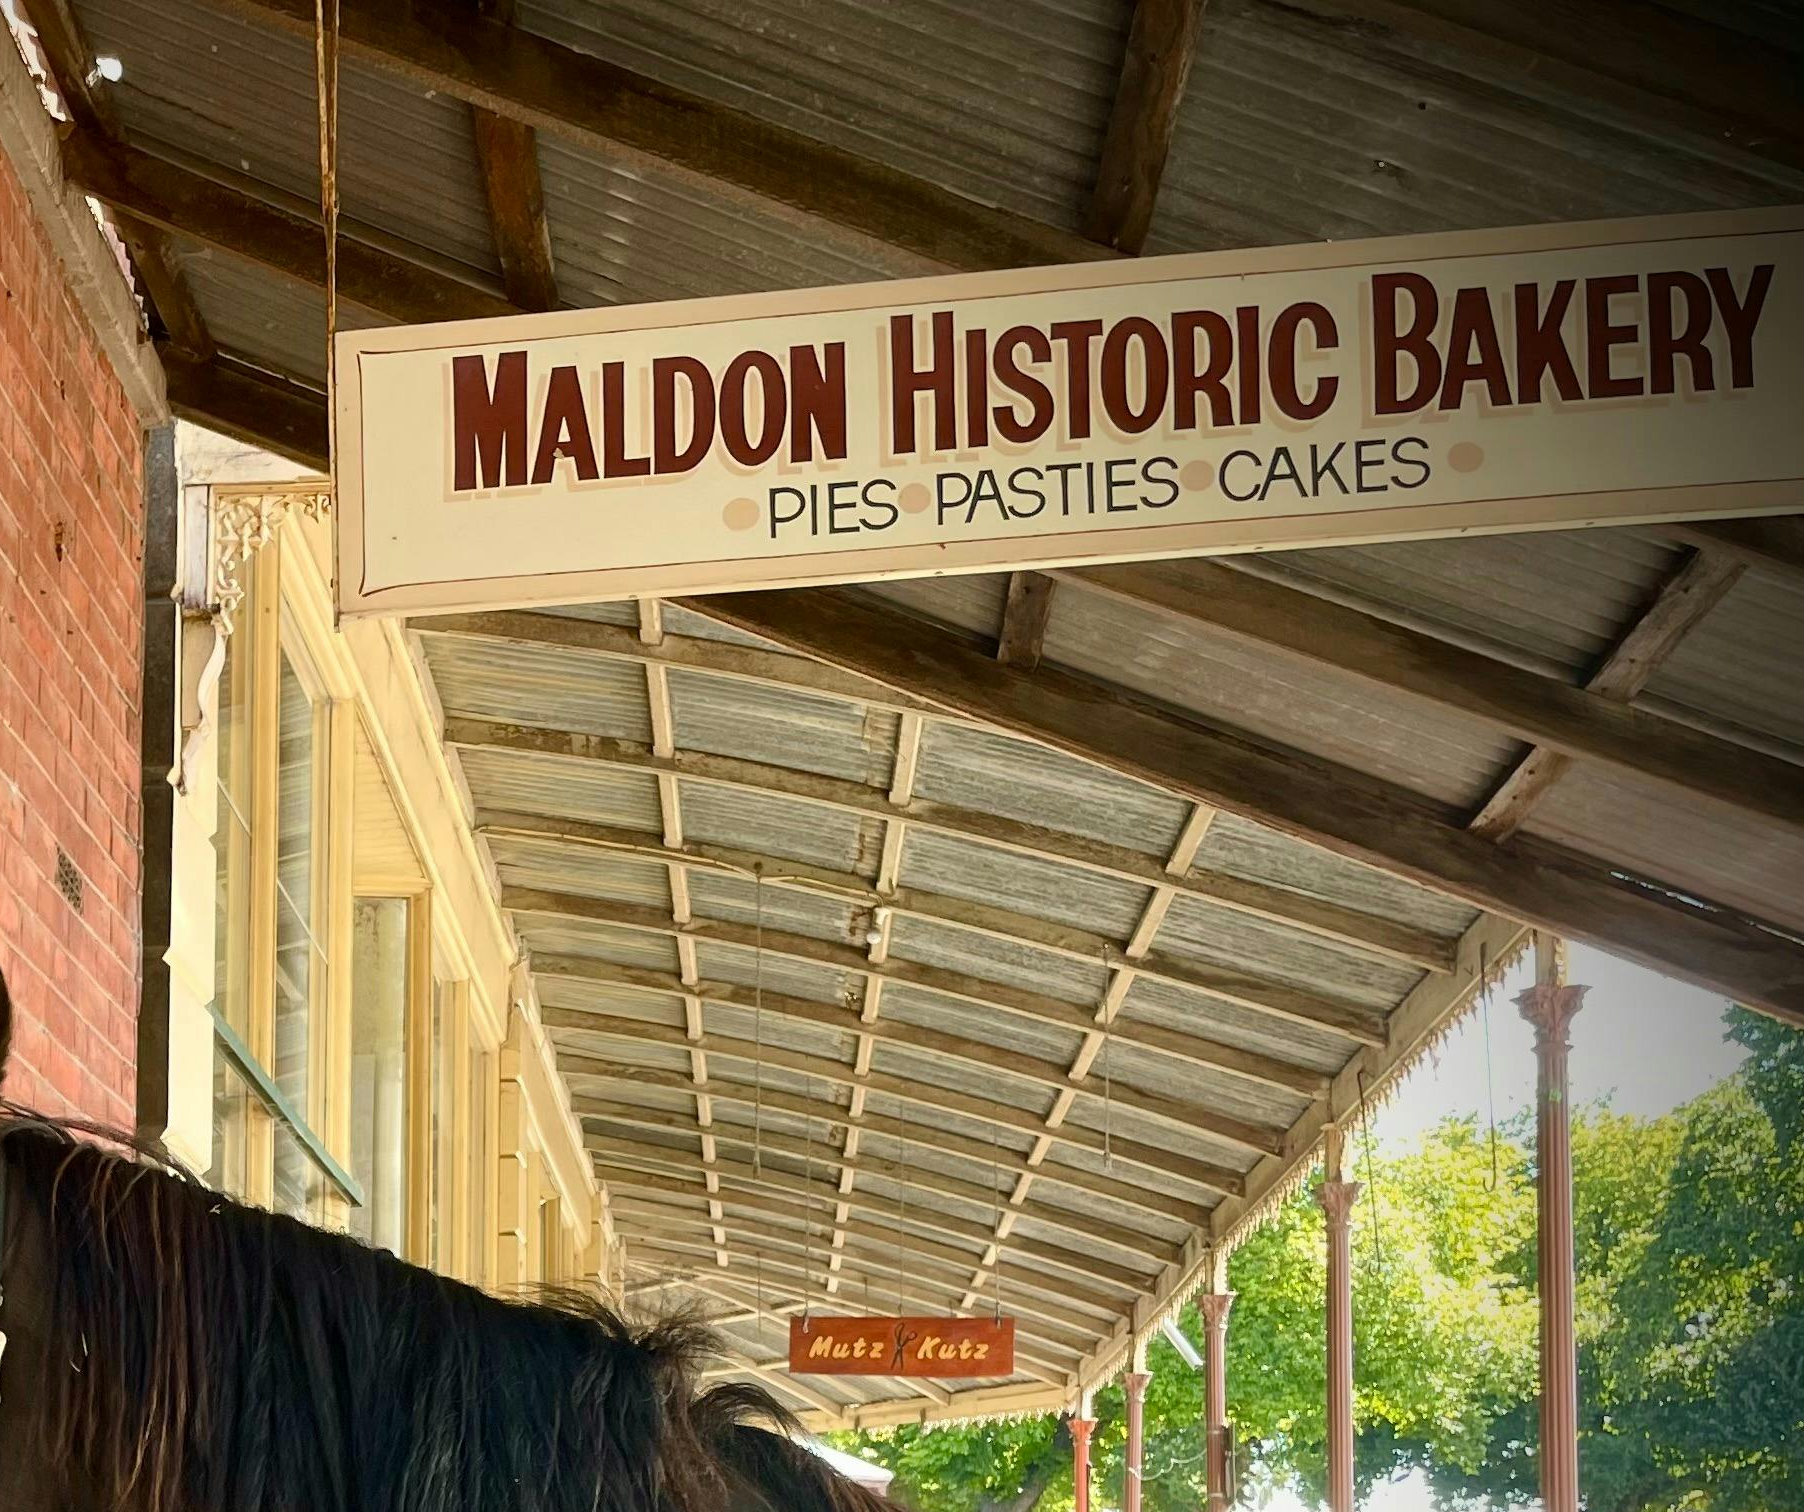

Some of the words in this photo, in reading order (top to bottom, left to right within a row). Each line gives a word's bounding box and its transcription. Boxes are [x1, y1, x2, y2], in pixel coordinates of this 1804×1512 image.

[452, 350, 848, 491] MALDON
[890, 311, 1340, 455] HISTORIC
[1371, 264, 1775, 416] BAKERY
[768, 478, 899, 538] PIES
[936, 455, 1181, 525] PASTIES
[1218, 436, 1431, 502] CAKES
[809, 1336, 884, 1358] Mutz
[917, 1336, 989, 1359] Kutz
